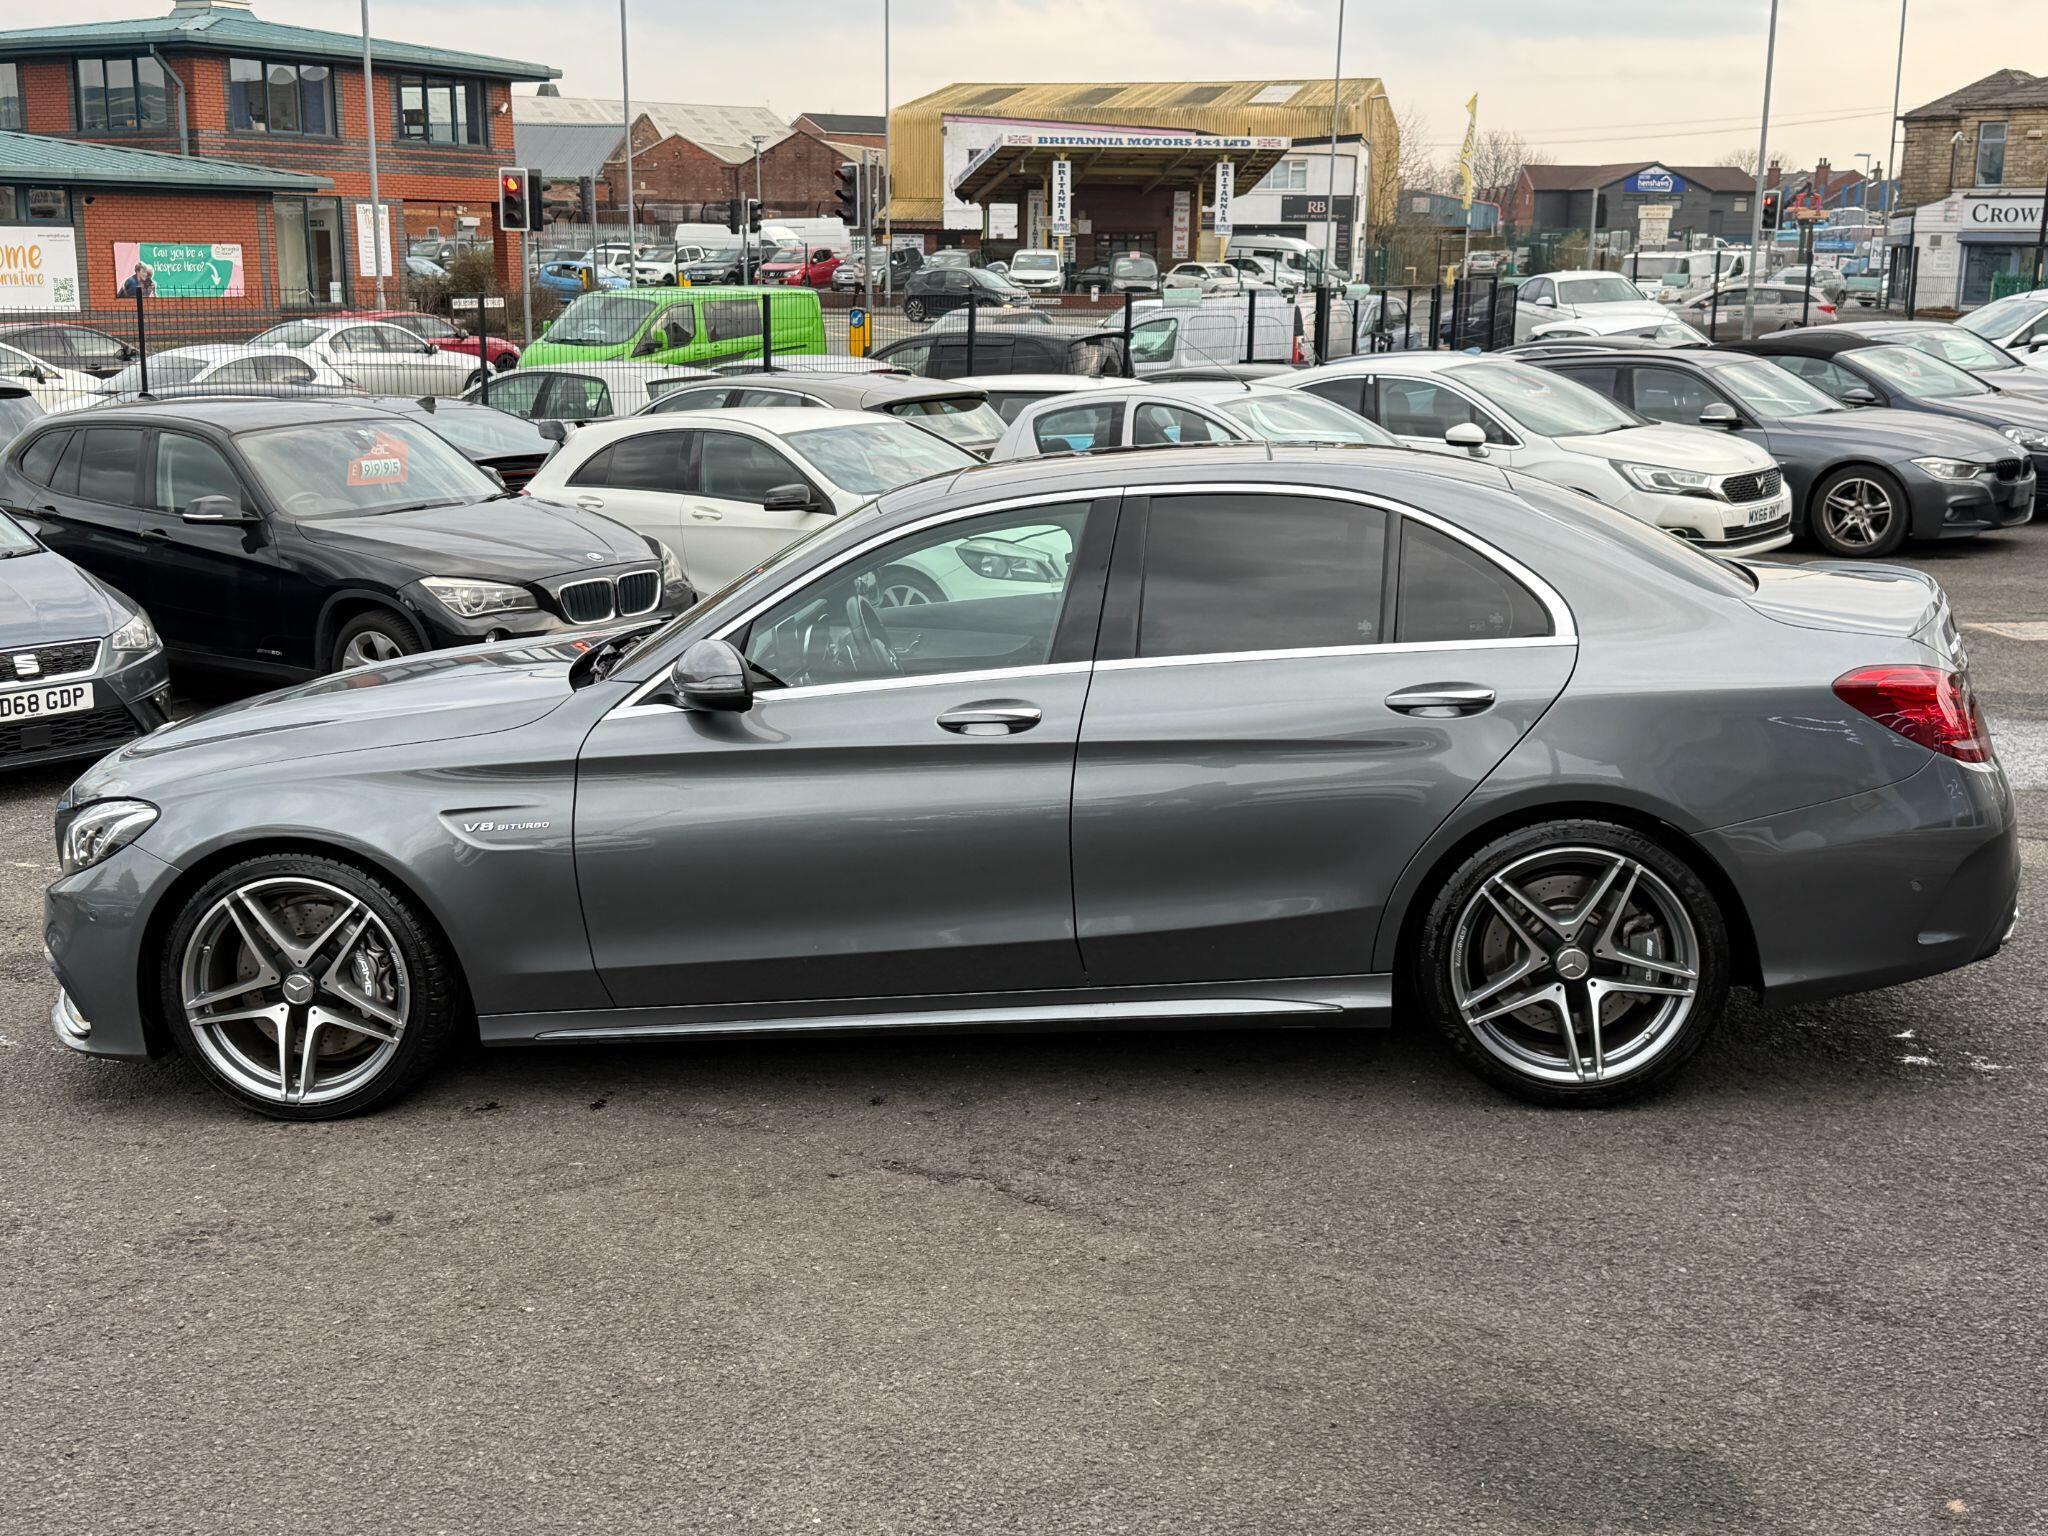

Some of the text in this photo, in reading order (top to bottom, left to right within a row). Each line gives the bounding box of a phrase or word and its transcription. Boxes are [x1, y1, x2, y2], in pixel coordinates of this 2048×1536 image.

[1038, 136, 1251, 147] BRITANNIA MOTORS 4x4 LTD
[1057, 163, 1066, 222] BRITANNIA
[1219, 164, 1230, 222] BRITANNIA
[1307, 201, 1327, 213] RB
[1972, 203, 2043, 223] CROW
[153, 247, 204, 261] Can you be a
[154, 261, 182, 276] Hospice
[364, 462, 400, 476] 9995
[0, 687, 84, 718] D68 GDP
[463, 821, 550, 833] V8 BITURBO
[357, 957, 372, 997] AMG
